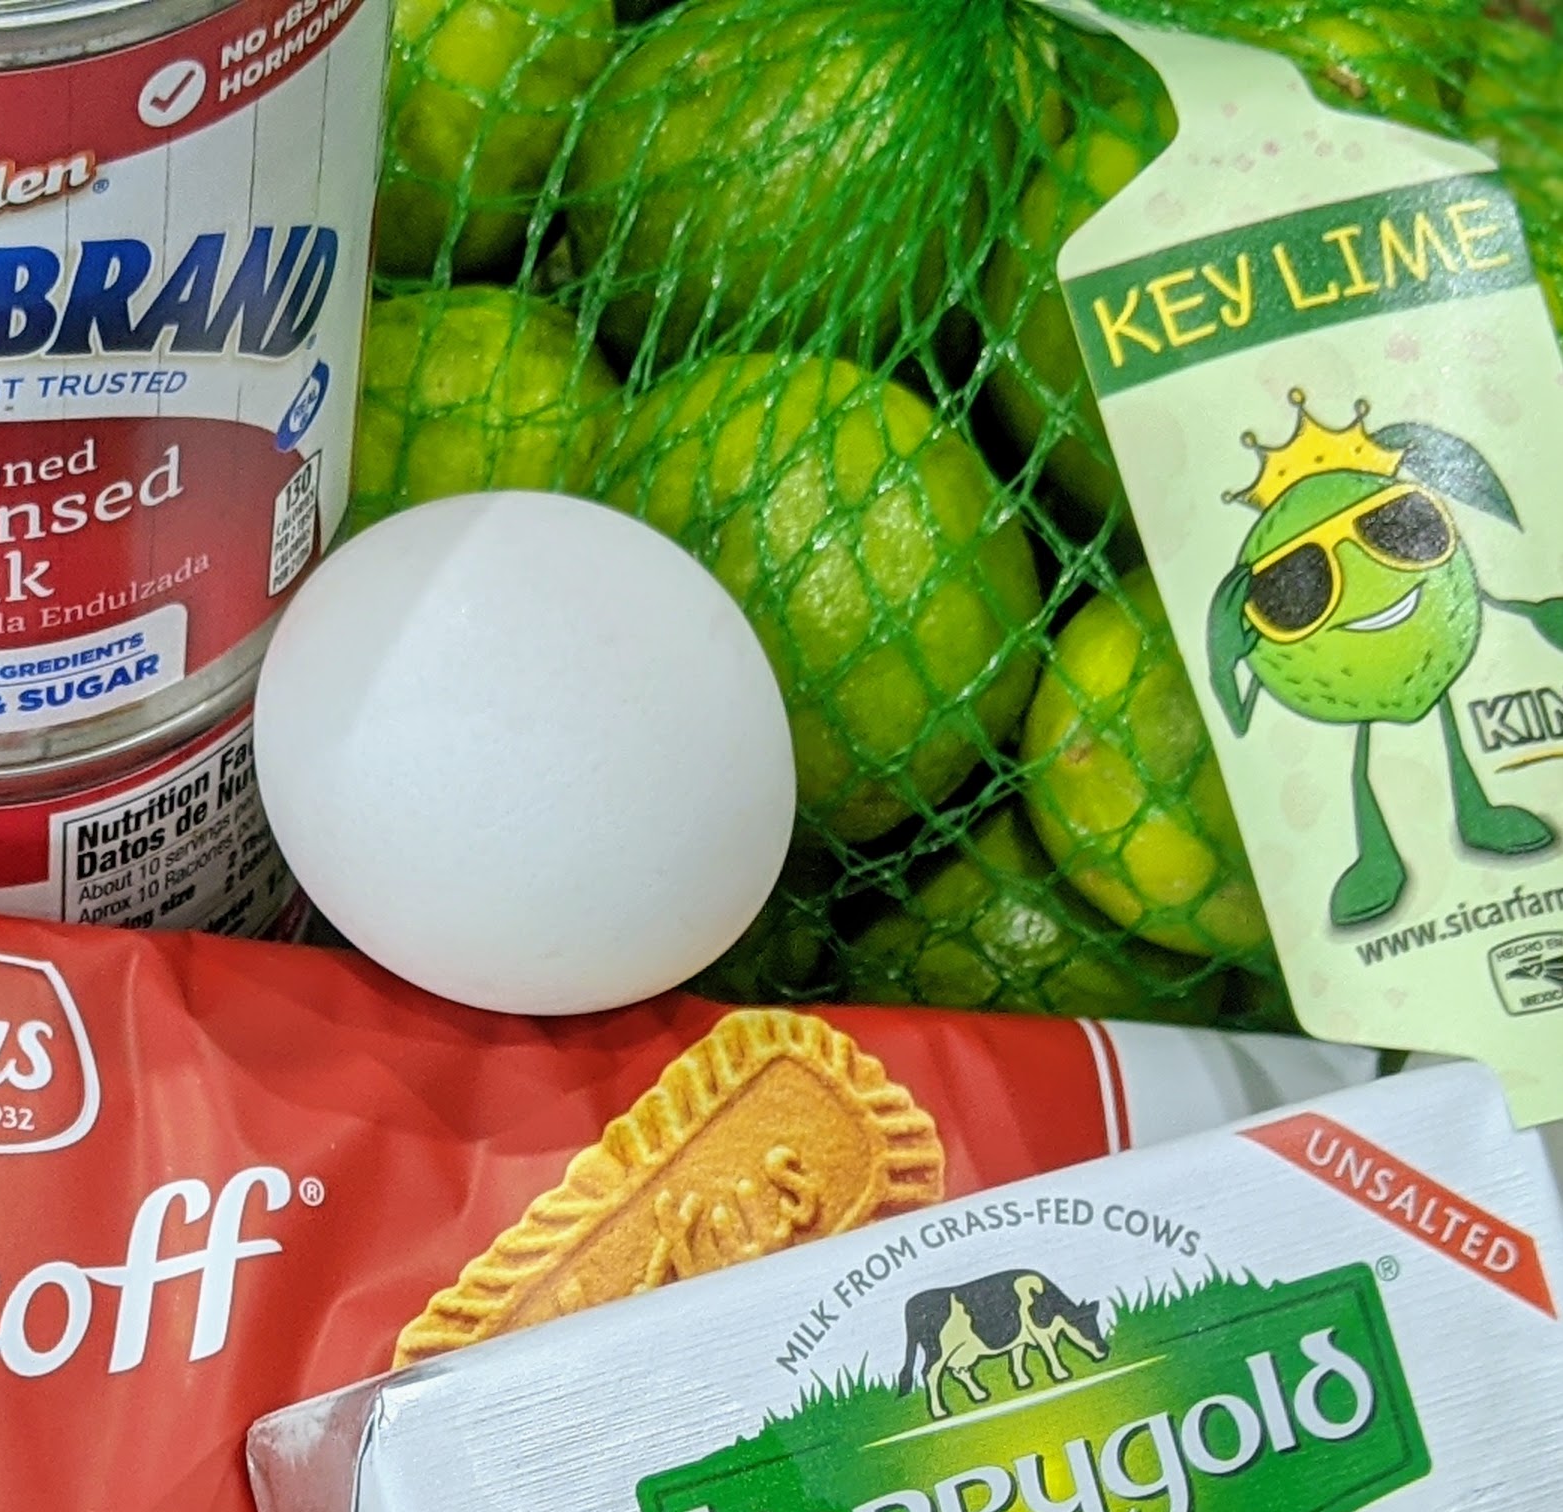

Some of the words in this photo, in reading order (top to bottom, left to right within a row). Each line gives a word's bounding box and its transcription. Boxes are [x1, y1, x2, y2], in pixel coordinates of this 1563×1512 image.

[220, 28, 268, 70] NO
[273, 0, 326, 40] rBS
[1092, 250, 1253, 370] KEY
[1270, 197, 1514, 312] LIME
[35, 370, 189, 400] TRUSTED
[39, 552, 211, 630] Endulzada
[16, 652, 161, 714] SUGAR
[75, 826, 167, 881] Datos
[175, 800, 208, 837] de
[76, 770, 211, 854] Nutrition
[78, 869, 133, 905] About
[139, 856, 161, 880] 10
[78, 895, 132, 926] Aprox
[138, 879, 160, 903] 10
[1304, 1126, 1520, 1275] UNSALTED
[775, 1299, 840, 1377] MILK
[832, 1234, 919, 1310] FROM
[918, 1197, 1096, 1252] GRASS-FED
[1102, 1203, 1202, 1259] COWS
